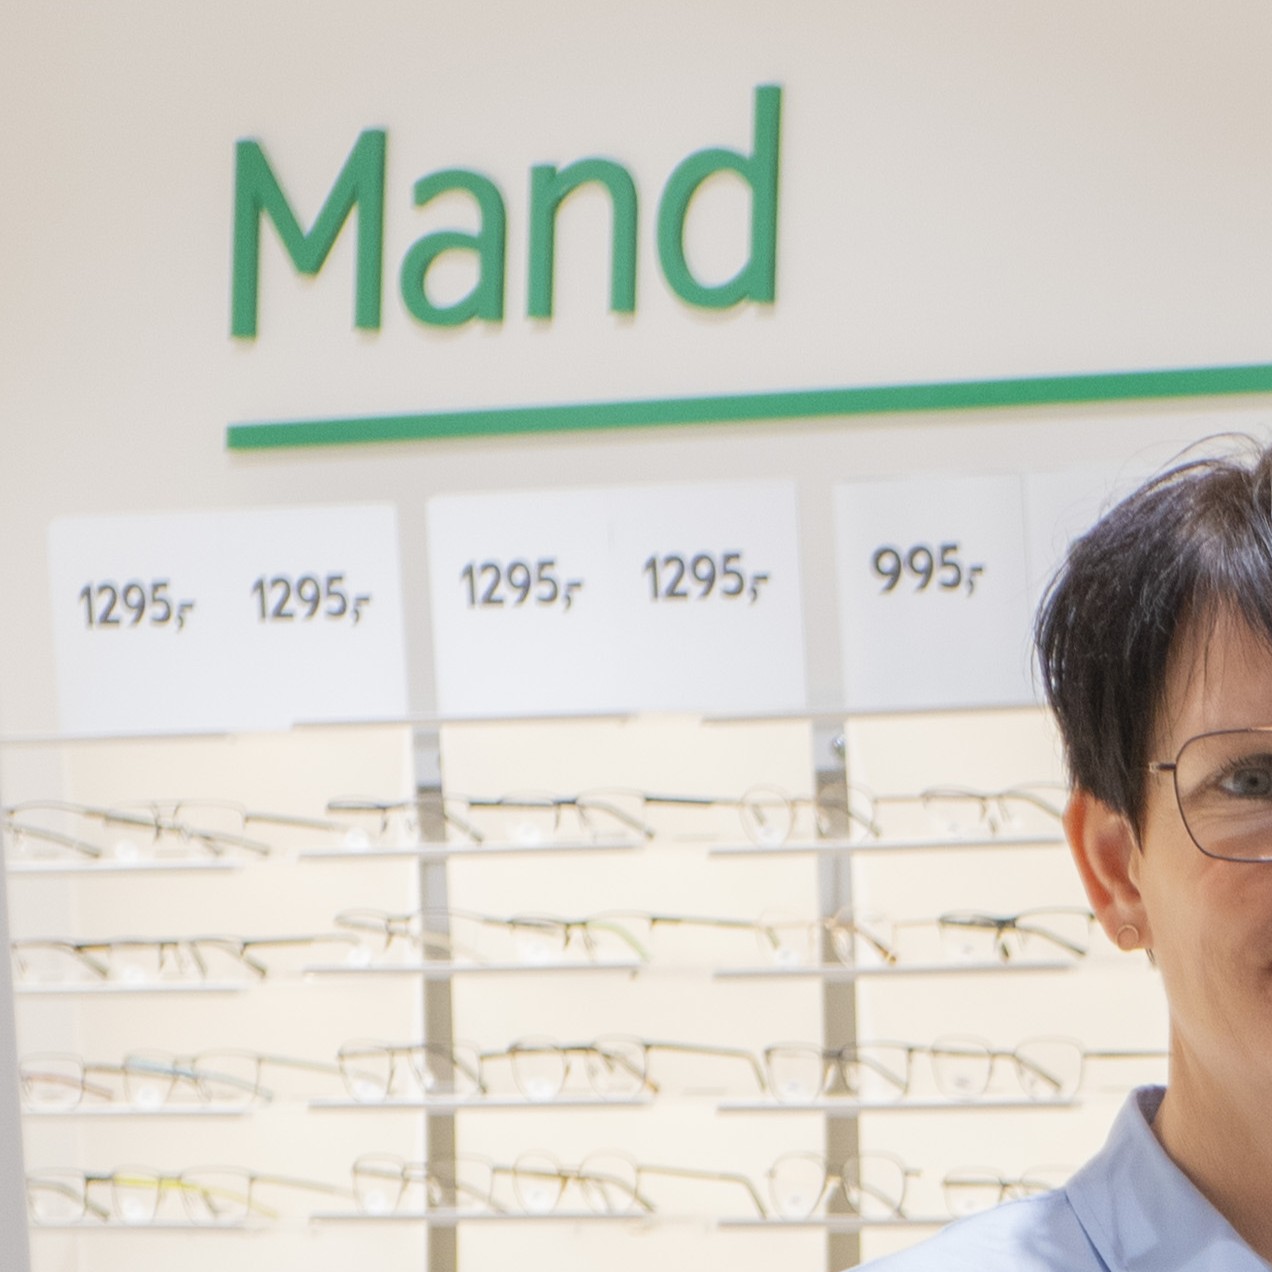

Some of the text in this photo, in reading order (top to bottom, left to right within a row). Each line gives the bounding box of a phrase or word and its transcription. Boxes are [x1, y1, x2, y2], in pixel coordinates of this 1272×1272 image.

[230, 84, 783, 339] Mand
[462, 558, 583, 612] 1295,-
[644, 550, 769, 606] 1295,-
[872, 543, 984, 597] 995,-
[80, 579, 194, 632] 1295,-
[252, 572, 371, 625] 1295,-
